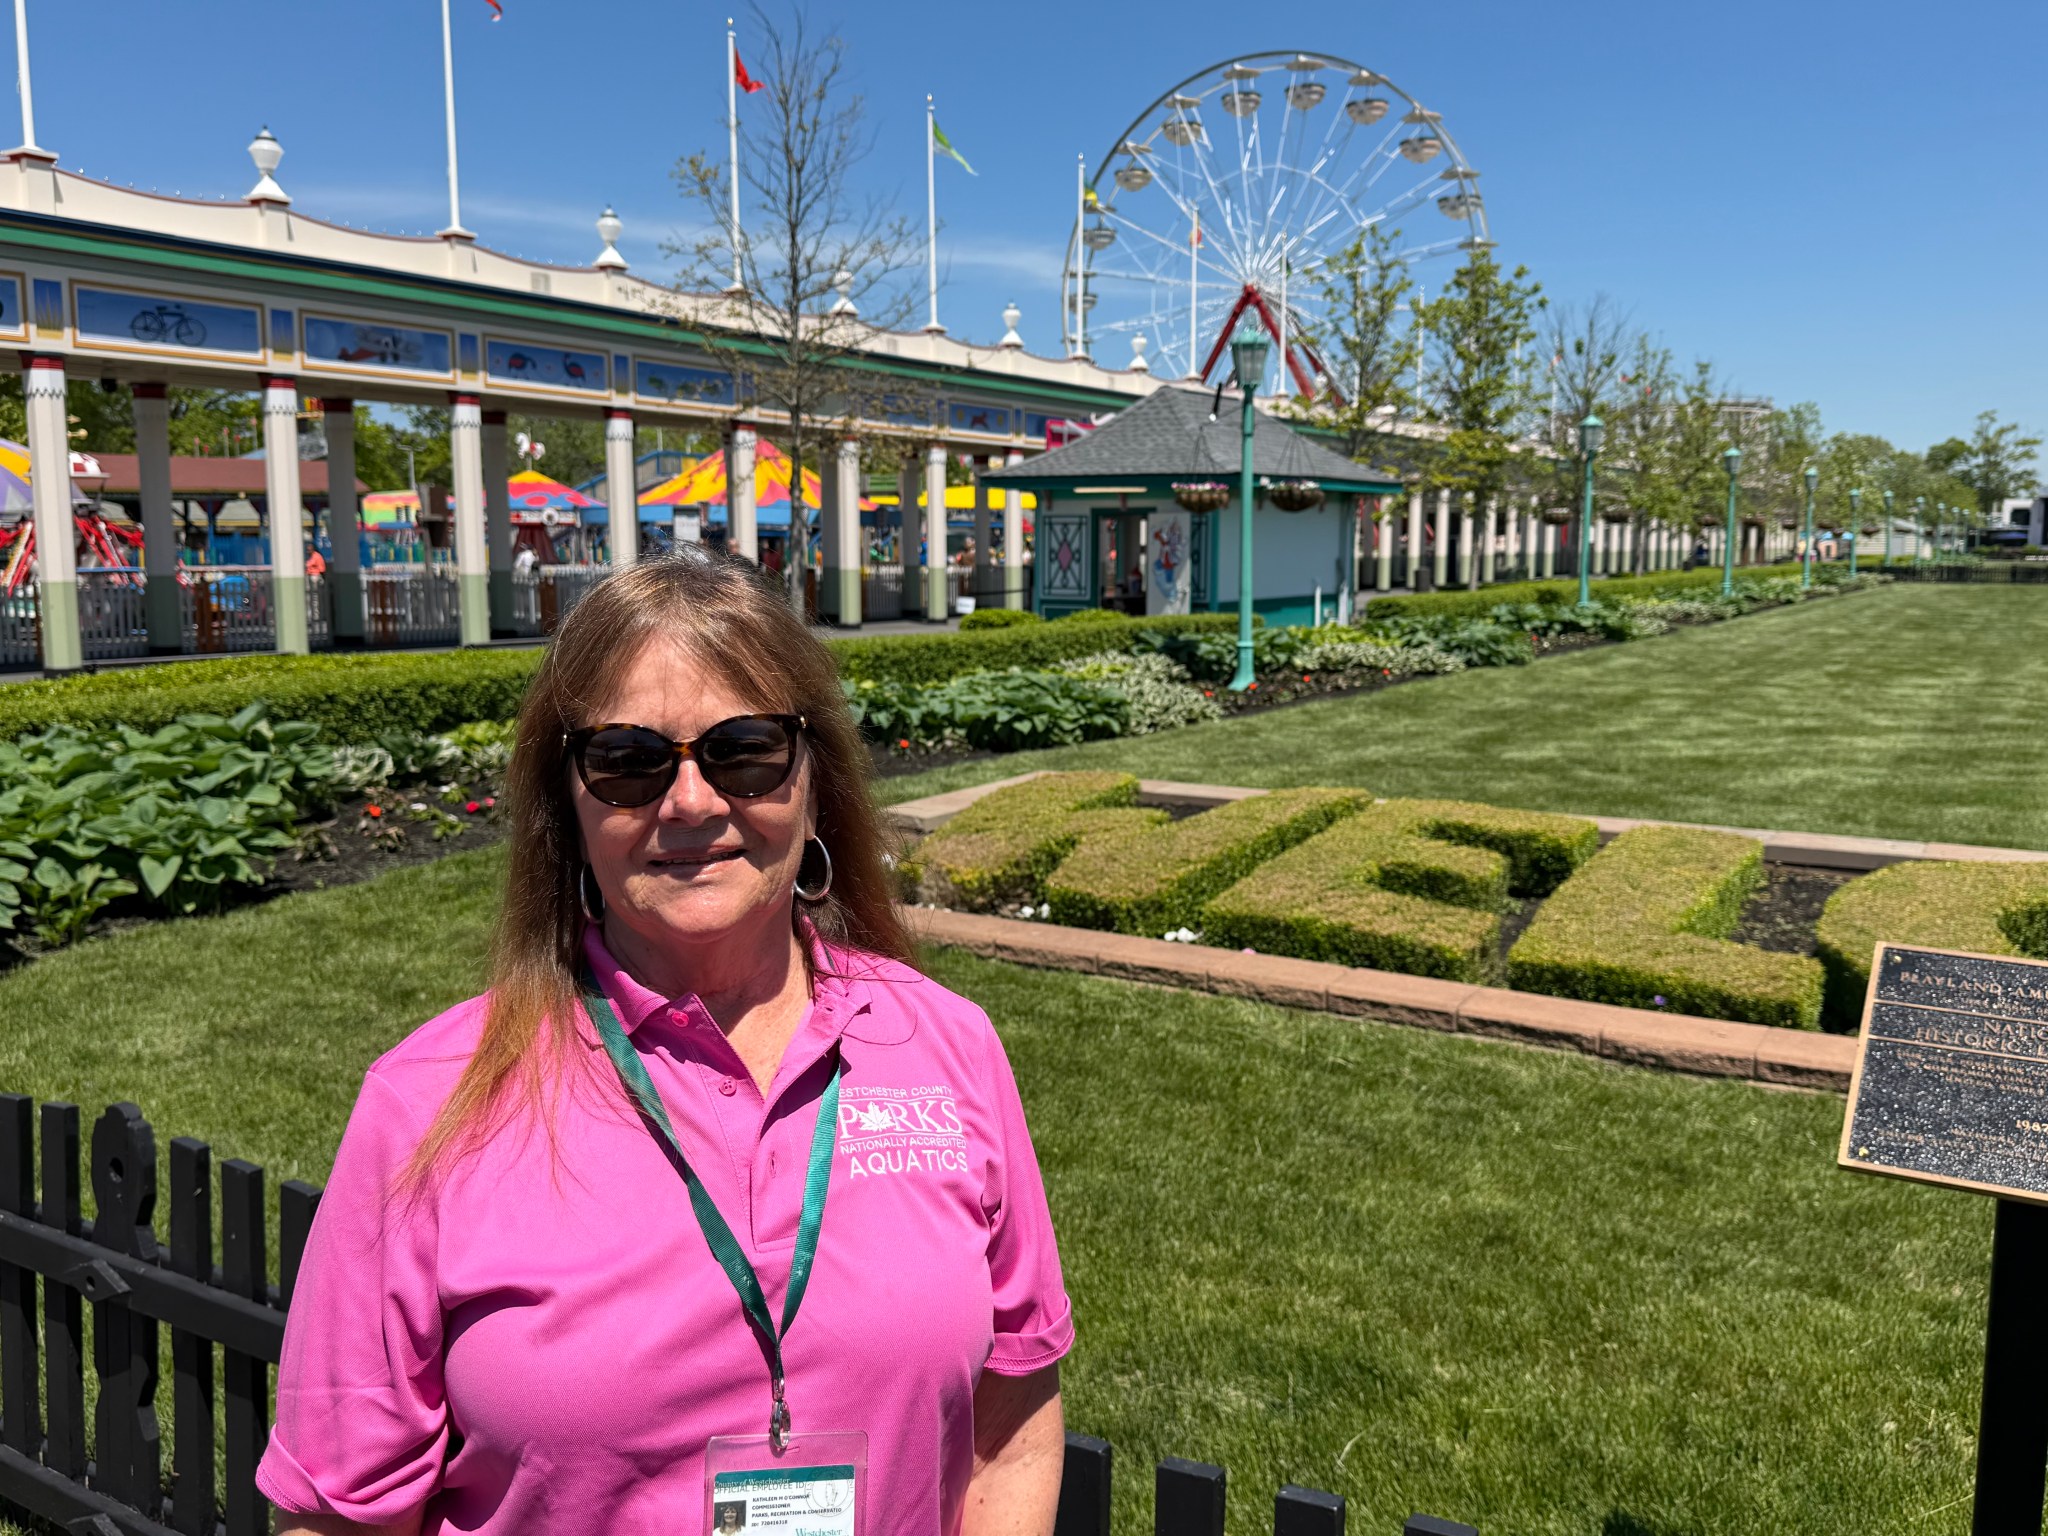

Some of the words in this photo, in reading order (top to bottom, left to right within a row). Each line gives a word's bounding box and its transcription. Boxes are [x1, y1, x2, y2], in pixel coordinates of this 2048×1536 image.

[1899, 971, 2003, 996] PLAYLAND
[2013, 986, 2048, 1001] AM
[1915, 1026, 2021, 1054] HISTORIC
[839, 1086, 908, 1098] ESTCHESTER
[911, 1085, 953, 1097] COUNTY
[840, 1136, 907, 1155] NATIONALLY
[909, 1135, 967, 1149] ACCREDITED
[849, 1149, 968, 1179] AQUATICS
[714, 1485, 750, 1495] OFFICIAL
[752, 1482, 793, 1492] EMPLOYEE
[795, 1481, 804, 1489] ID
[748, 1477, 790, 1487] Westchester
